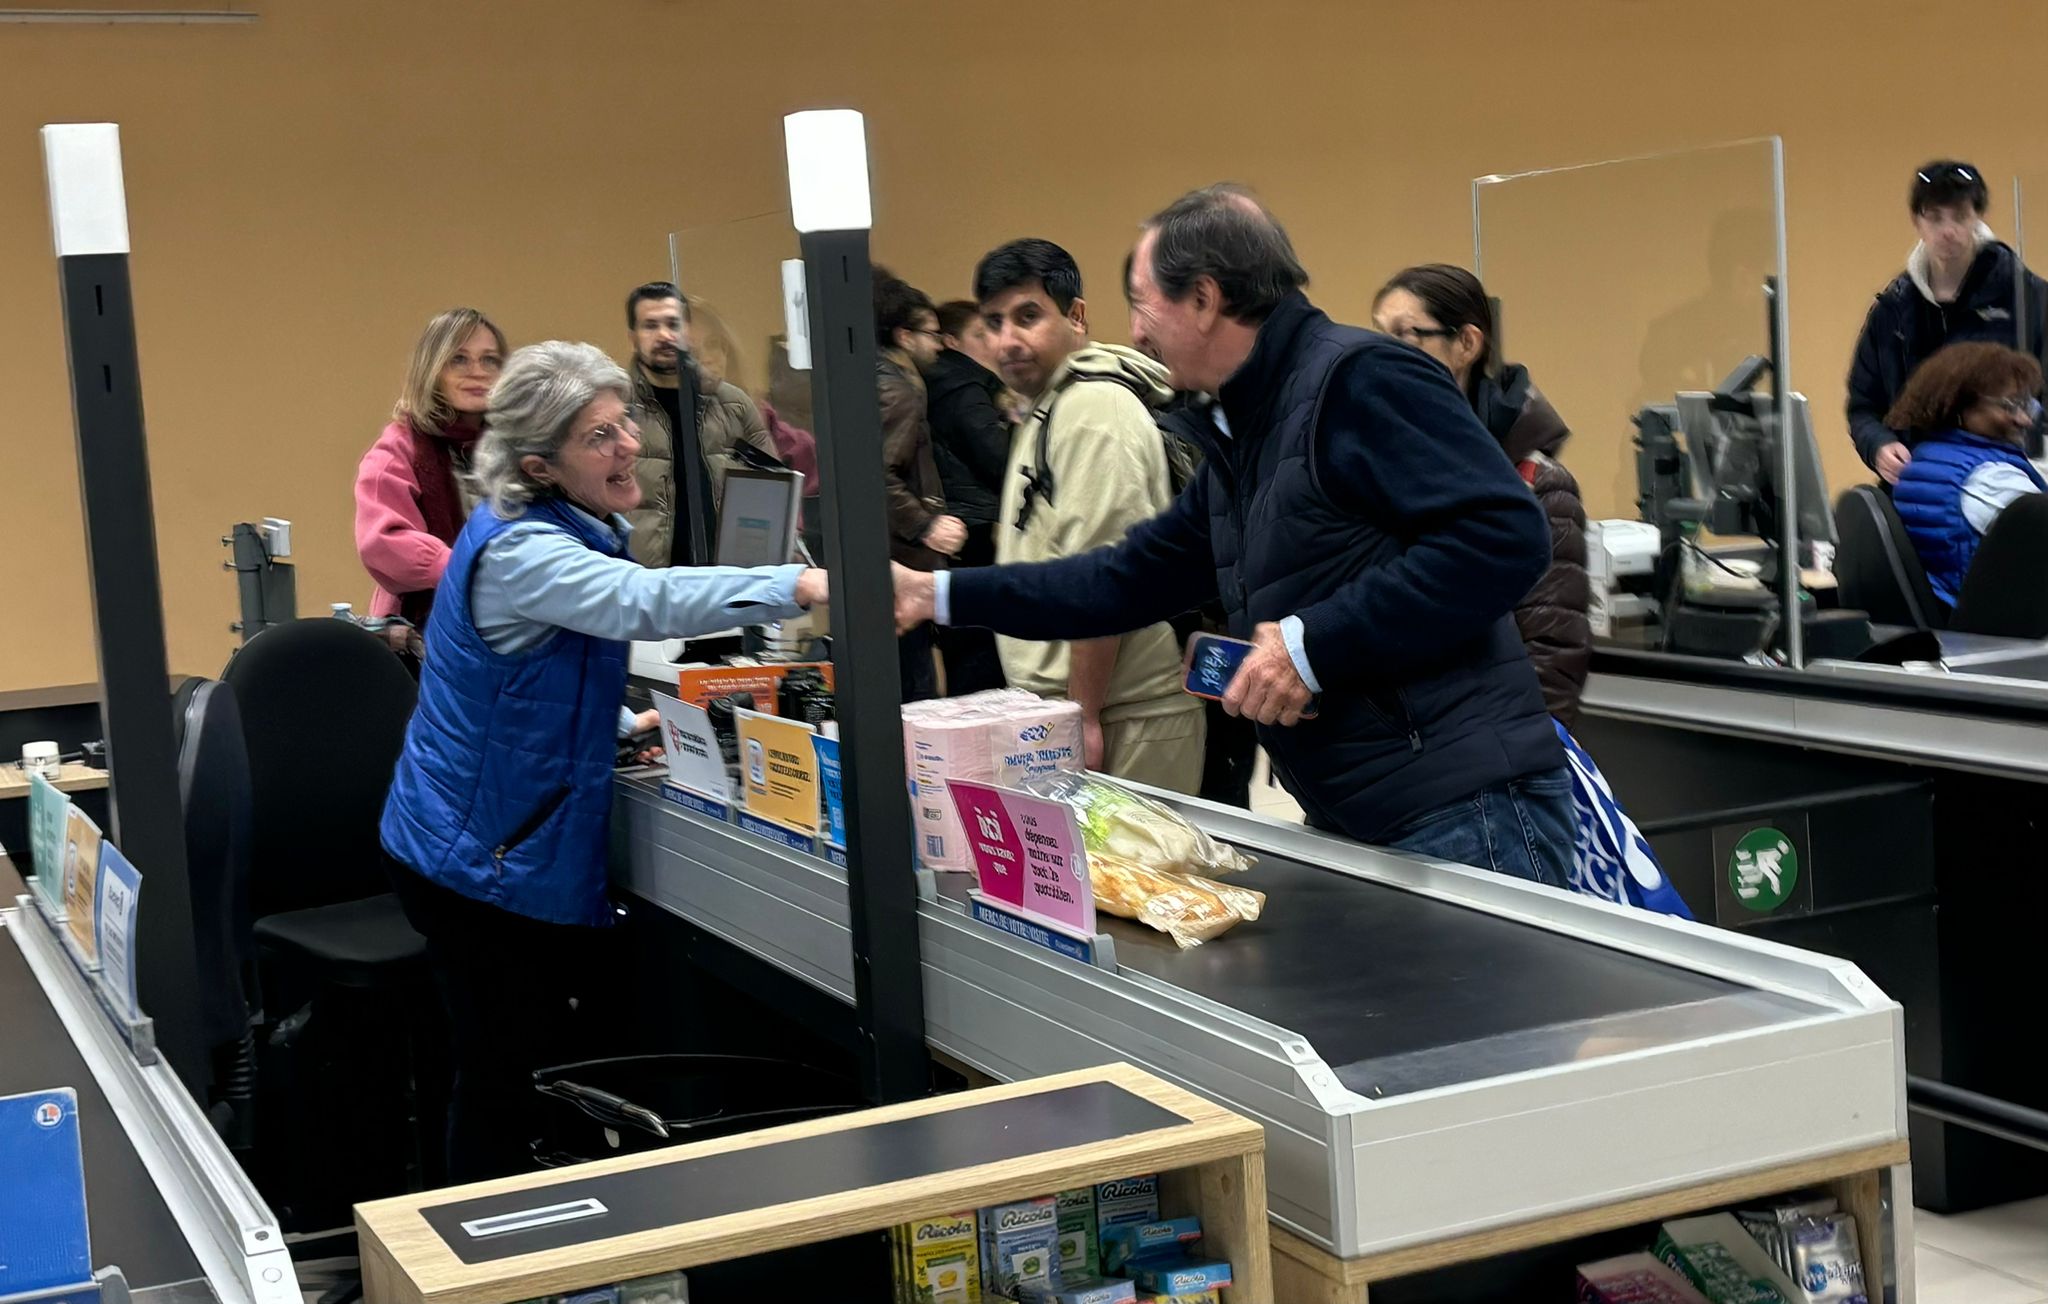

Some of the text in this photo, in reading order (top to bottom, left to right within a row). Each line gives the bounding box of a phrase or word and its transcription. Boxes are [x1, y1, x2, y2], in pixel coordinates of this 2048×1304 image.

[973, 807, 1004, 843] ici
[1102, 1180, 1153, 1200] Ricola
[1056, 1194, 1090, 1209] cola
[1001, 1207, 1053, 1228] Ricola
[916, 1220, 973, 1241] Ricola
